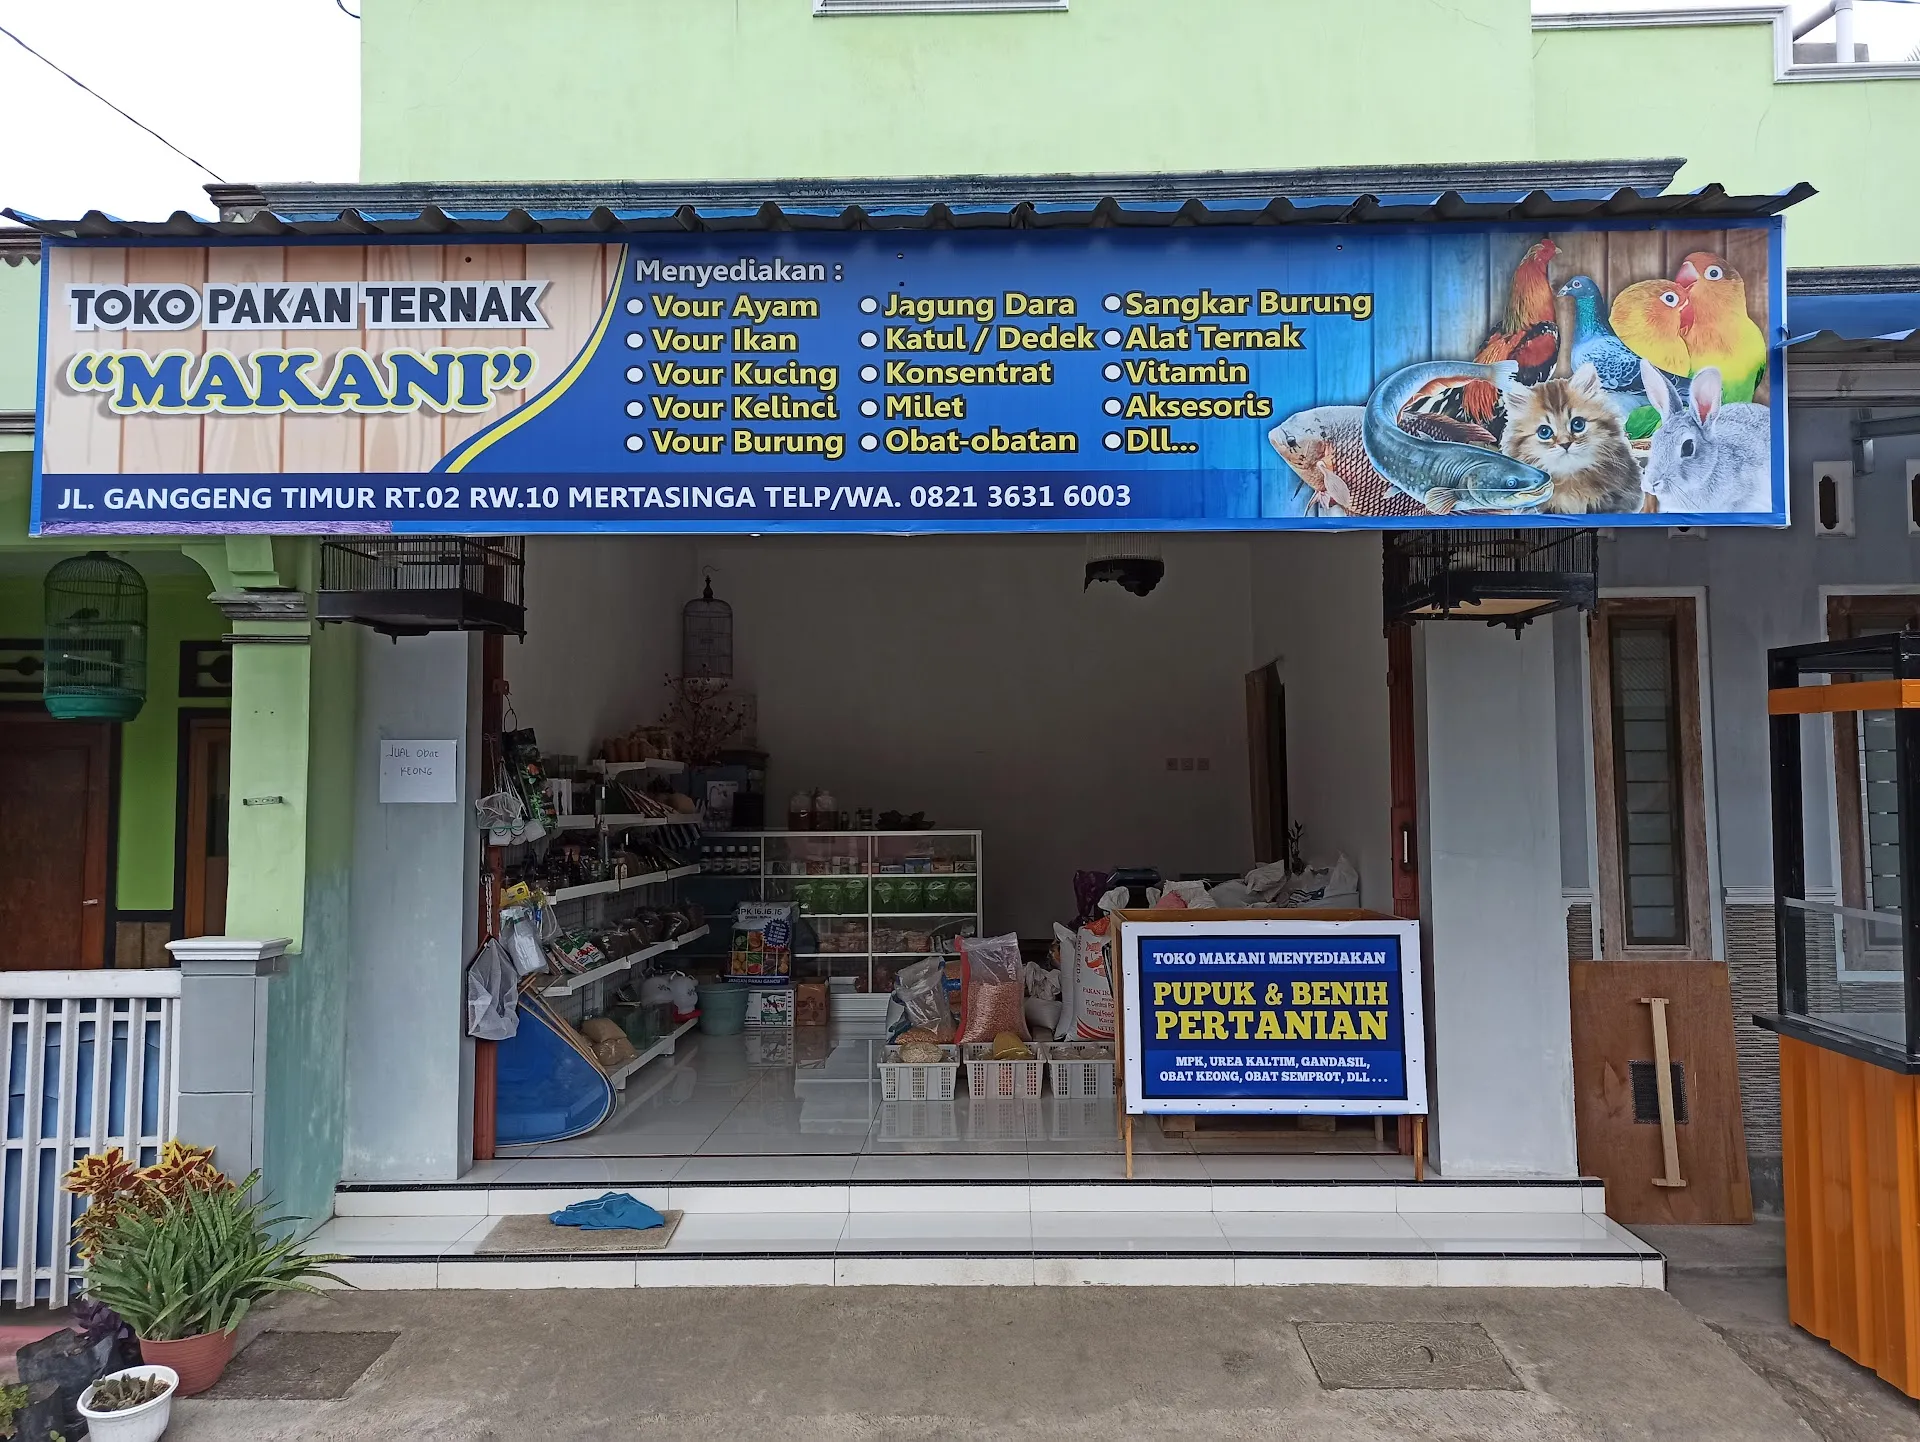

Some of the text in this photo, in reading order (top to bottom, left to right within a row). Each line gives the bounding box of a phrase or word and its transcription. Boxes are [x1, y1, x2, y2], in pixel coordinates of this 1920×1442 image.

[636, 258, 825, 288] Menyediakan
[71, 286, 539, 325] TOKO PAKAN TERNAK
[653, 295, 817, 323] Vour Ayam
[885, 293, 1074, 323] Jagung Dara
[1127, 291, 1371, 321] Sangkar Burung
[653, 327, 796, 351] Vour Ikan
[886, 325, 1095, 353] Katul / Dedek
[1125, 324, 1300, 349] Alat Ternak
[652, 361, 837, 391] Vour Kucing
[886, 362, 1051, 384] Konsentrat
[1126, 359, 1247, 383] Vitamin
[652, 395, 836, 419] Vour Kelinci
[887, 394, 964, 418] Milet
[1126, 393, 1271, 418] Aksesoris
[652, 430, 843, 459] Vour Burung
[886, 428, 1076, 452] Obat-obatan
[1127, 428, 1196, 452] Dll...
[57, 484, 1131, 511] JL. GANGGENG TIMUR RT.02 RW.10 MERTASINGA TELP/WA. 0821 3631 6003
[386, 745, 411, 758] JUAL
[400, 766, 433, 777] KEONG
[1153, 951, 1386, 965] TOKO MAKANI MENYEDIAKAN
[1153, 981, 1388, 1006] PUPUK & BENIH
[1156, 1011, 1388, 1040] PERTANIAN
[1175, 1056, 1371, 1070] MPK, UREA KALTIM, GANDASIL,
[1159, 1071, 1194, 1082] OBAT
[1195, 1071, 1243, 1084] KEONG,
[1244, 1071, 1279, 1082] OBAT
[1281, 1071, 1345, 1084] SEMPROT,
